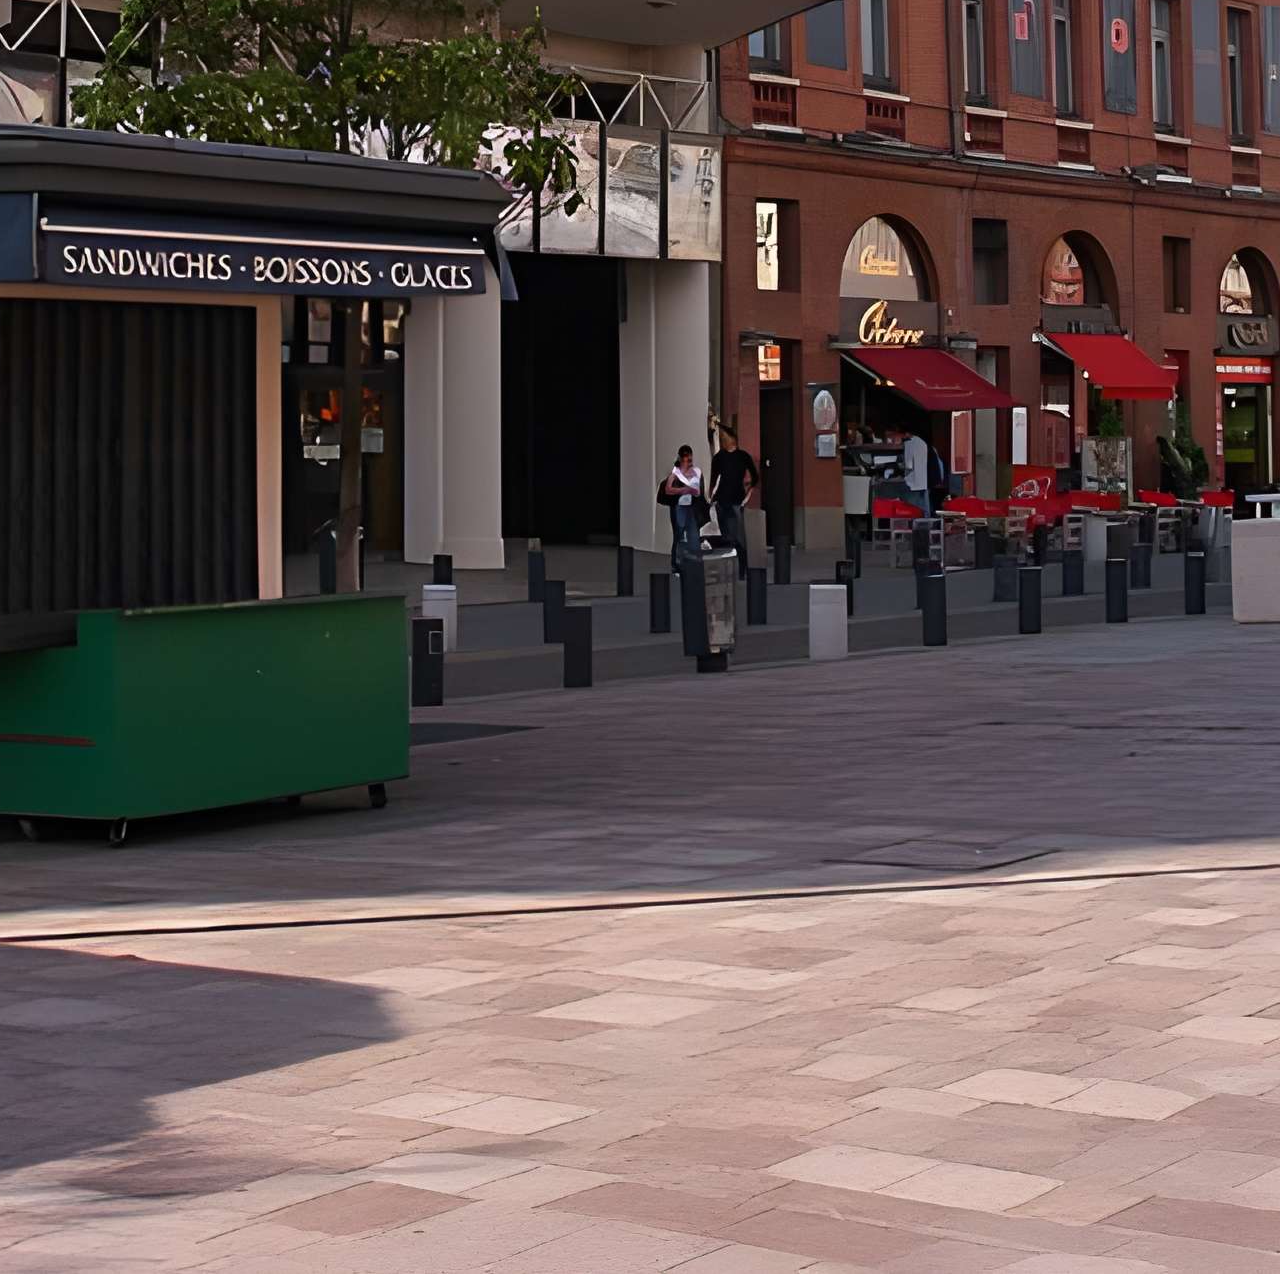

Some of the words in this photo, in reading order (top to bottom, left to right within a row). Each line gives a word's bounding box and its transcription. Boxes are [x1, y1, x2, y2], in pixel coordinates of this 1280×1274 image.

[63, 245, 232, 281] SANDWICHES
[254, 255, 372, 287] BOISSONS
[391, 262, 473, 290] GLACES
